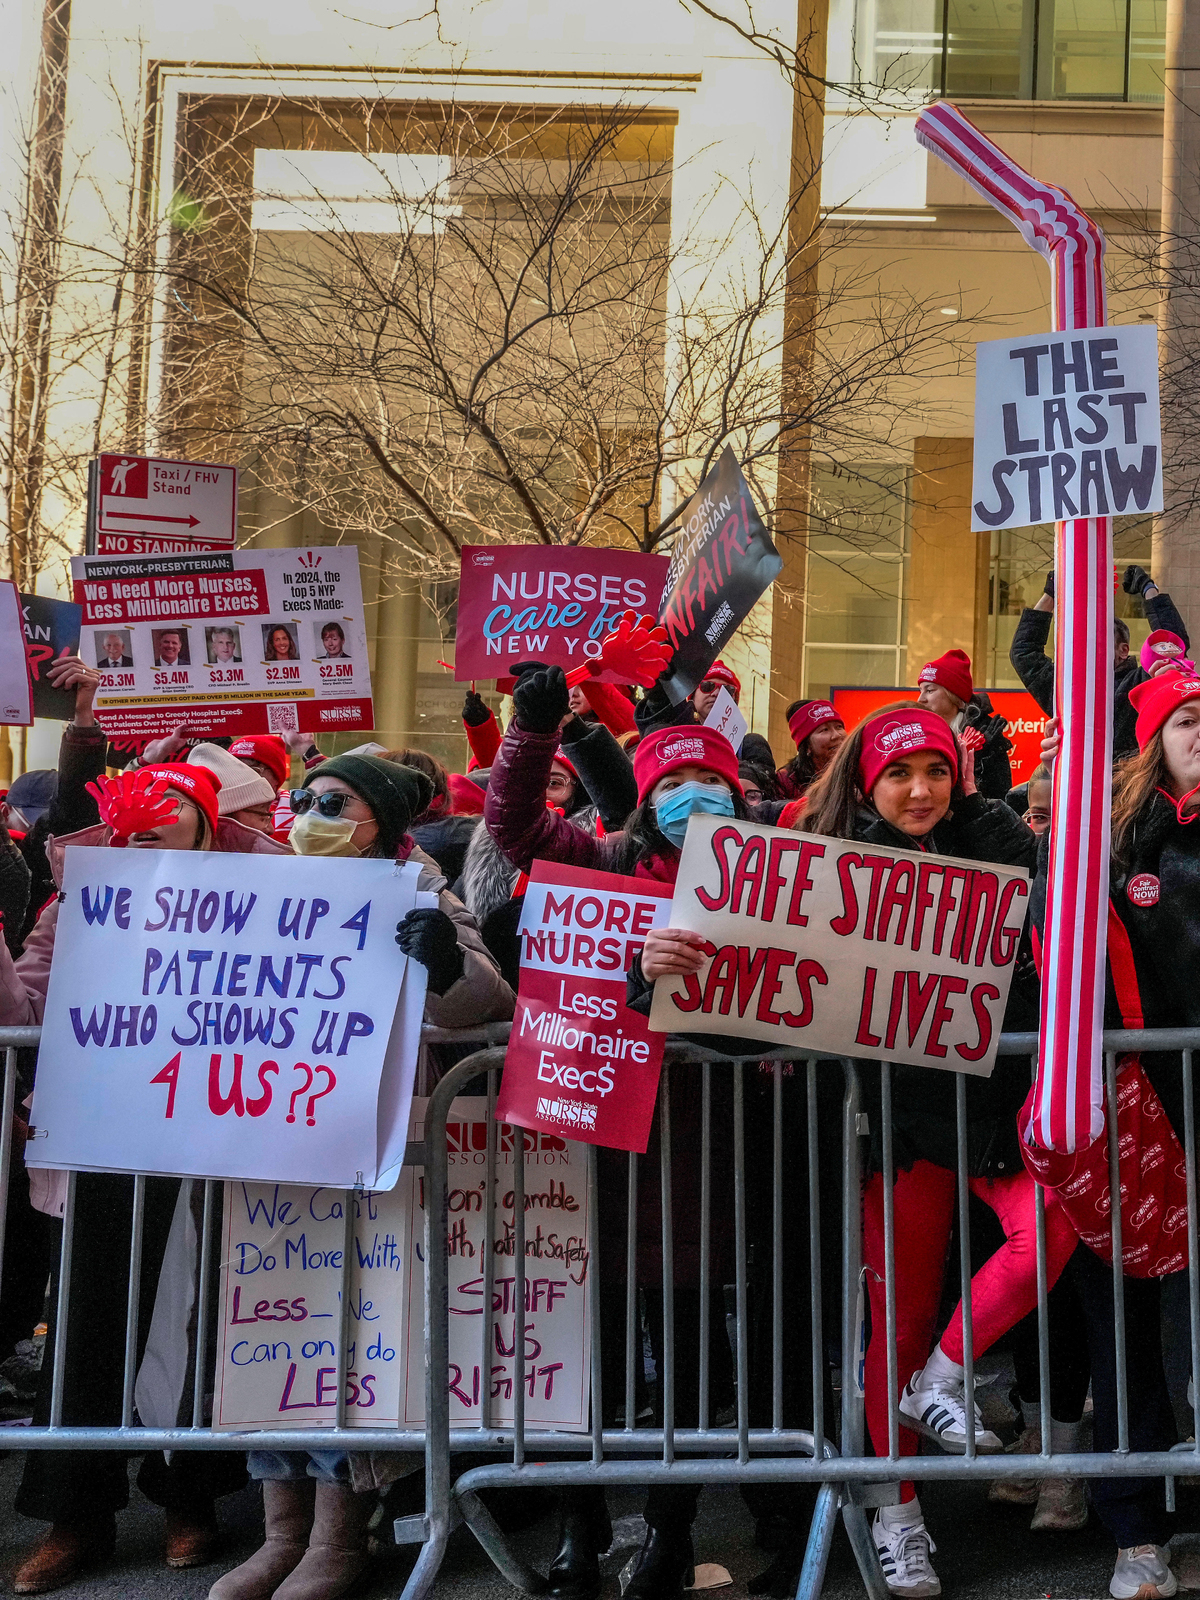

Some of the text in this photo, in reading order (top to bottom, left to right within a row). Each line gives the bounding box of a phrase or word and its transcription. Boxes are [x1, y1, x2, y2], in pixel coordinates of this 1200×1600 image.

[1009, 338, 1125, 397] THE
[1002, 392, 1148, 456] LAST
[153, 467, 220, 484] Taxi / FHV
[153, 481, 191, 495] Stand
[974, 445, 1158, 526] STRAW
[105, 536, 128, 551] NO
[283, 571, 340, 584] In 2024, the
[660, 497, 753, 650] NFAIR!
[84, 577, 257, 601] We Need More Nurses,
[291, 585, 335, 599] top 5 NYP
[492, 571, 647, 608] NURSES
[87, 594, 259, 619] Less Millionaire Exec$
[282, 599, 344, 612] Exec$ Made:
[704, 603, 731, 643] NURSES
[486, 635, 603, 658] NEW YO
[98, 673, 135, 687] 26.3M
[154, 671, 189, 685] $5.4M
[210, 669, 244, 683] $3.3M
[266, 666, 300, 680] $2.9M
[319, 664, 353, 678] $2.5M
[125, 713, 155, 721] Message
[165, 711, 190, 720] Greedy
[191, 709, 219, 718] Hospital
[320, 709, 361, 719] NURSES
[130, 727, 159, 735] Deserve
[881, 725, 923, 746] NURSES
[663, 739, 704, 754] NURSES
[694, 826, 1029, 968] SAFE STAFFING
[1134, 890, 1159, 899] NOW!
[81, 885, 371, 951] WE SHOW UP 4
[542, 891, 657, 936] MORE
[522, 927, 648, 974] NURSE
[141, 947, 352, 1000] PATIENTS
[558, 980, 617, 1021] Less
[670, 939, 1000, 1061] SAVES LIVES
[69, 1000, 375, 1057] WHO SHOWS UP
[520, 1007, 650, 1063] Millionaire
[150, 1051, 181, 1119] 4
[537, 1050, 616, 1097] Exec$
[536, 1097, 598, 1125] NURSES
[557, 1096, 598, 1110] New York State
[535, 1112, 597, 1132] ASSOCIATION
[242, 1182, 301, 1229] We
[235, 1233, 401, 1275] Do More With
[302, 1332, 396, 1369] ony do
[279, 1362, 377, 1412] LESS
